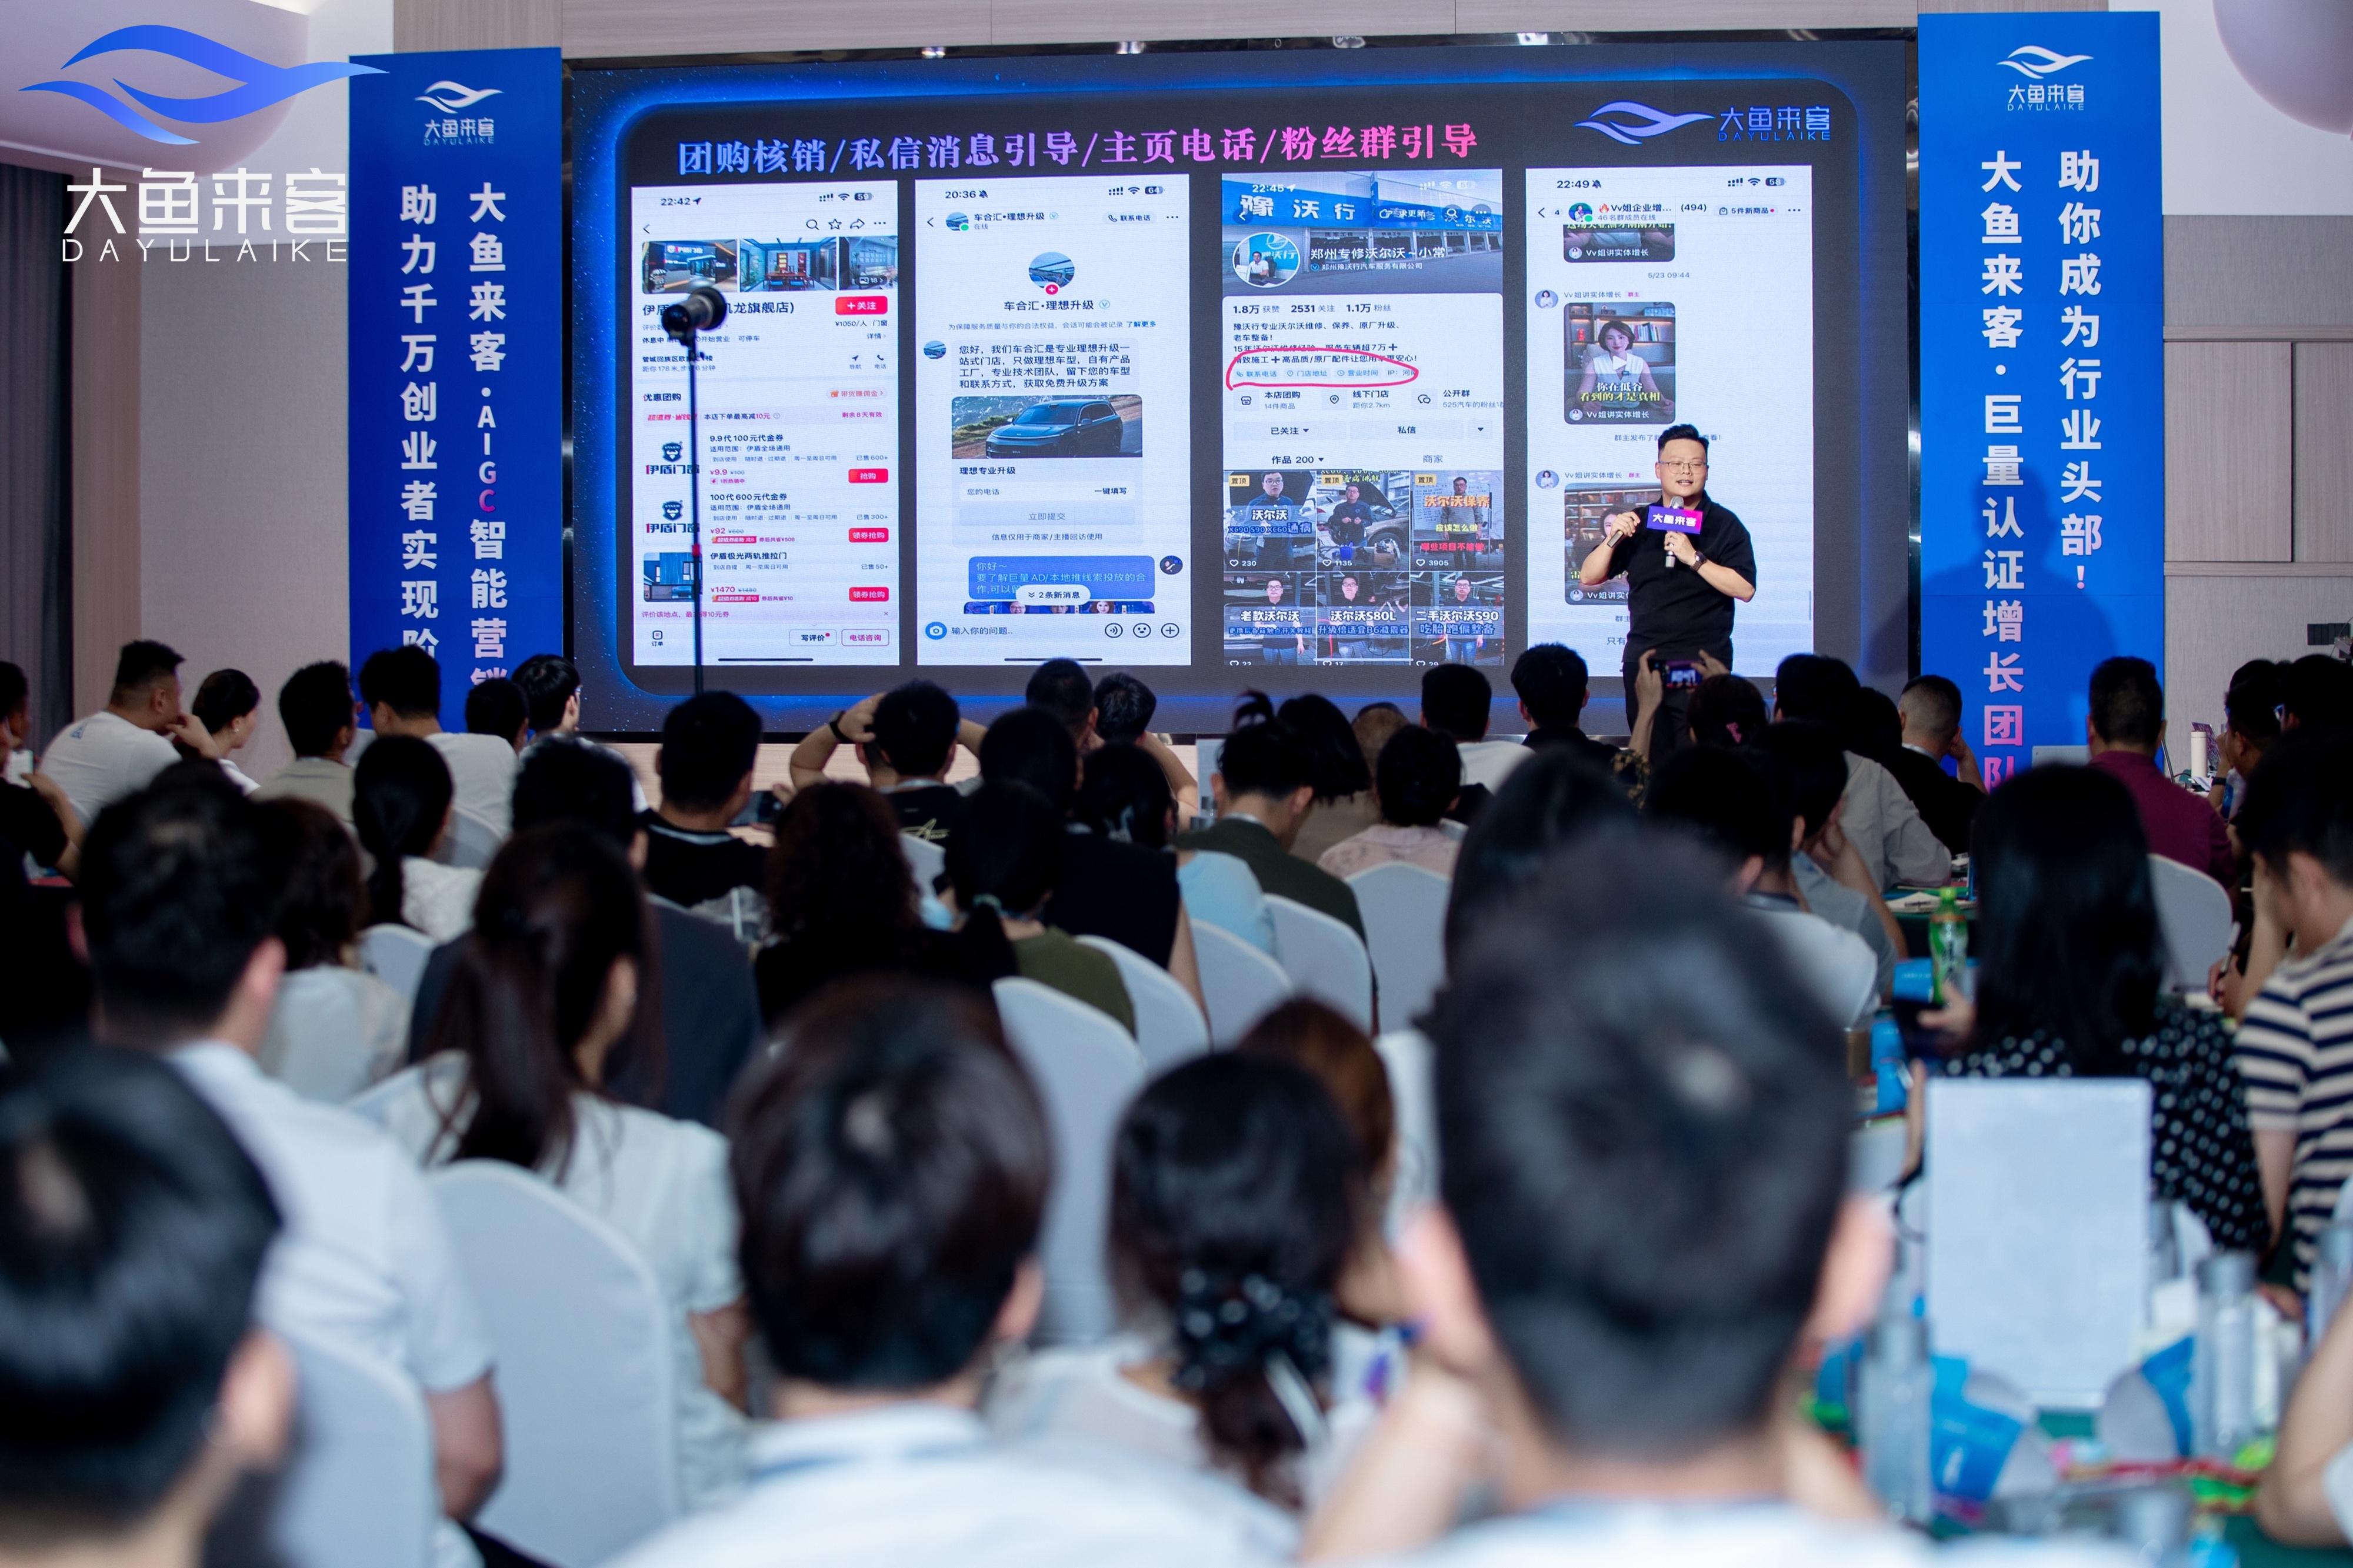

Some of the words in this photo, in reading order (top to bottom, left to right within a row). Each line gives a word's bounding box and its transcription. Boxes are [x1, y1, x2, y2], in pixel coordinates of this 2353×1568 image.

[2008, 84, 2084, 104] 大鱼来客
[1720, 107, 1831, 131] 大鱼来客
[424, 118, 495, 138] 大鱼来客
[1718, 131, 1831, 141] DAYULAIKE
[678, 123, 1478, 175] 团购核销/私信消息引导/主页电话/粉丝群引导
[1252, 184, 1285, 193] 22:45
[1557, 180, 1589, 189] 22:49
[945, 191, 976, 199] 20:36
[661, 198, 691, 206] 22:42
[1681, 203, 1707, 212] (494)
[1233, 305, 1259, 314] 1.8万
[1291, 305, 1315, 313] 2531
[1346, 303, 1371, 313] 1.1万
[1597, 382, 1643, 392] 你在低谷
[643, 393, 682, 402] 优惠团购
[1264, 391, 1301, 399] 本店团购
[1353, 390, 1389, 398] 线下门店
[1271, 427, 1299, 435] 已关注
[1397, 426, 1417, 435] 私信
[1271, 456, 1292, 465] 作品
[1296, 456, 1314, 464] 200
[1422, 455, 1443, 463] 商家
[959, 466, 1016, 475] 理想专业升级
[967, 488, 1000, 496] 您的电话
[1094, 487, 1127, 495] 一键填写
[1028, 512, 1066, 521] 立即提交
[1252, 509, 1288, 521] 沃尔沃
[1038, 590, 1080, 599] 2条新消息
[1240, 610, 1300, 622] 老款沃尔沃
